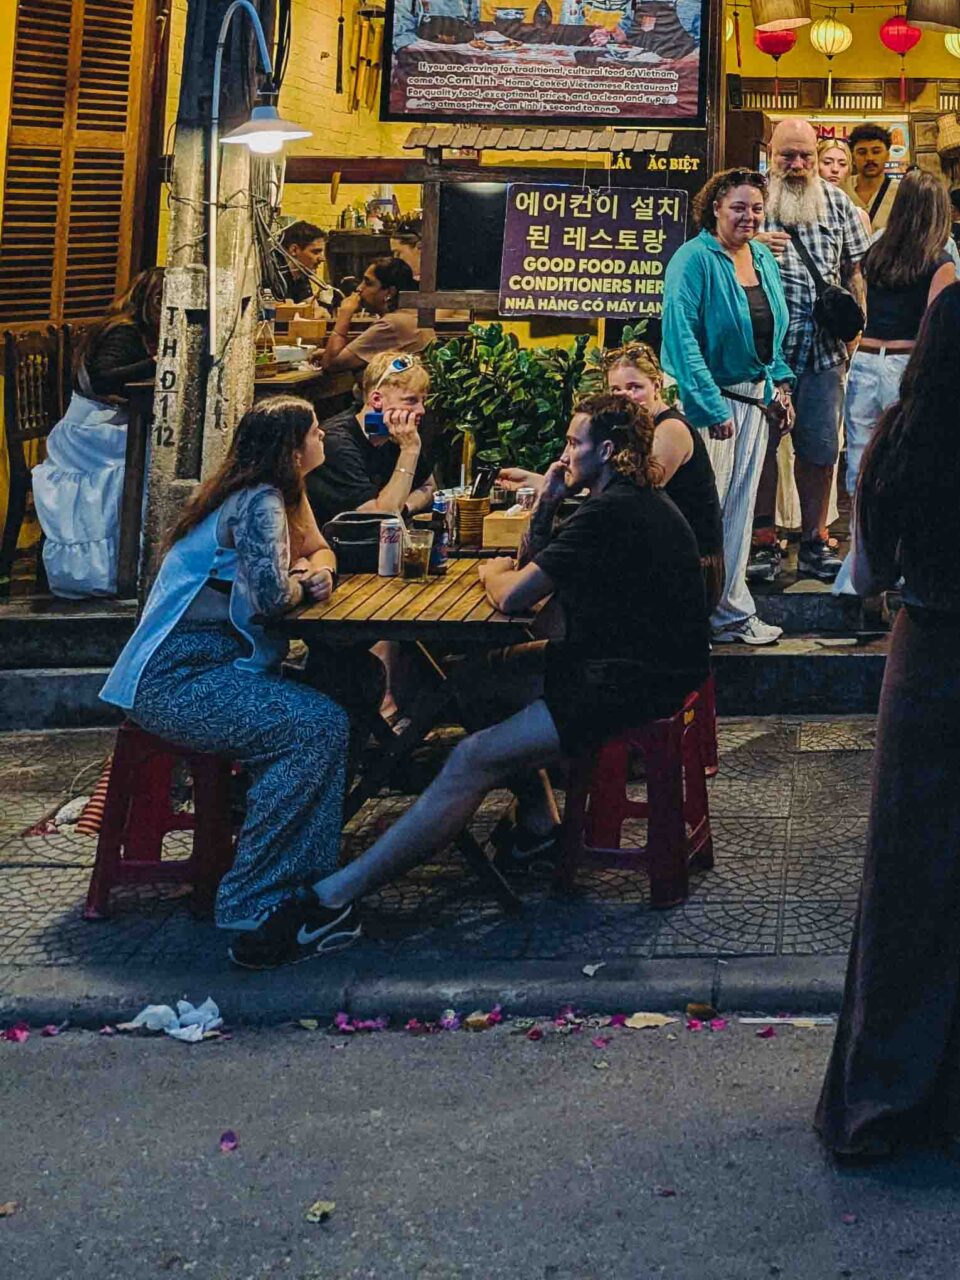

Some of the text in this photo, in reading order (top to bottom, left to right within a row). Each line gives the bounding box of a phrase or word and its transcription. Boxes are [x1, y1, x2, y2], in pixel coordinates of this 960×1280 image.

[427, 64, 445, 73] you
[464, 64, 498, 74] craving
[515, 65, 566, 75] traditional,
[567, 66, 602, 75] cultural
[604, 67, 624, 76] food
[626, 68, 637, 76] of
[637, 69, 678, 78] Vietnam,
[435, 76, 445, 84] to
[447, 75, 472, 85] Com
[474, 75, 497, 86] Linh
[505, 79, 531, 87] Home
[532, 79, 567, 88] Cooked
[570, 80, 622, 89] Vietnamese
[624, 82, 678, 91] Restaurant!
[407, 88, 422, 96] For
[425, 88, 458, 99] quality
[484, 90, 538, 99] exceptional
[572, 92, 589, 100] and
[599, 93, 624, 101] clean
[626, 94, 643, 102] and
[438, 100, 495, 110] atmosphere,
[497, 101, 518, 109] Com
[519, 101, 538, 110] Linh
[549, 103, 580, 111] second
[669, 154, 700, 173] BIỆT
[515, 191, 680, 222] 에어컨이 설치
[526, 225, 667, 254] 된 레스토랑
[523, 256, 663, 276] GOOD FOOD AND
[508, 275, 664, 295] CONDITIONERS HER
[505, 295, 535, 311] NHÀ
[538, 295, 579, 312] HÀNG
[581, 297, 604, 312] CÓ
[606, 298, 637, 313] MÁY
